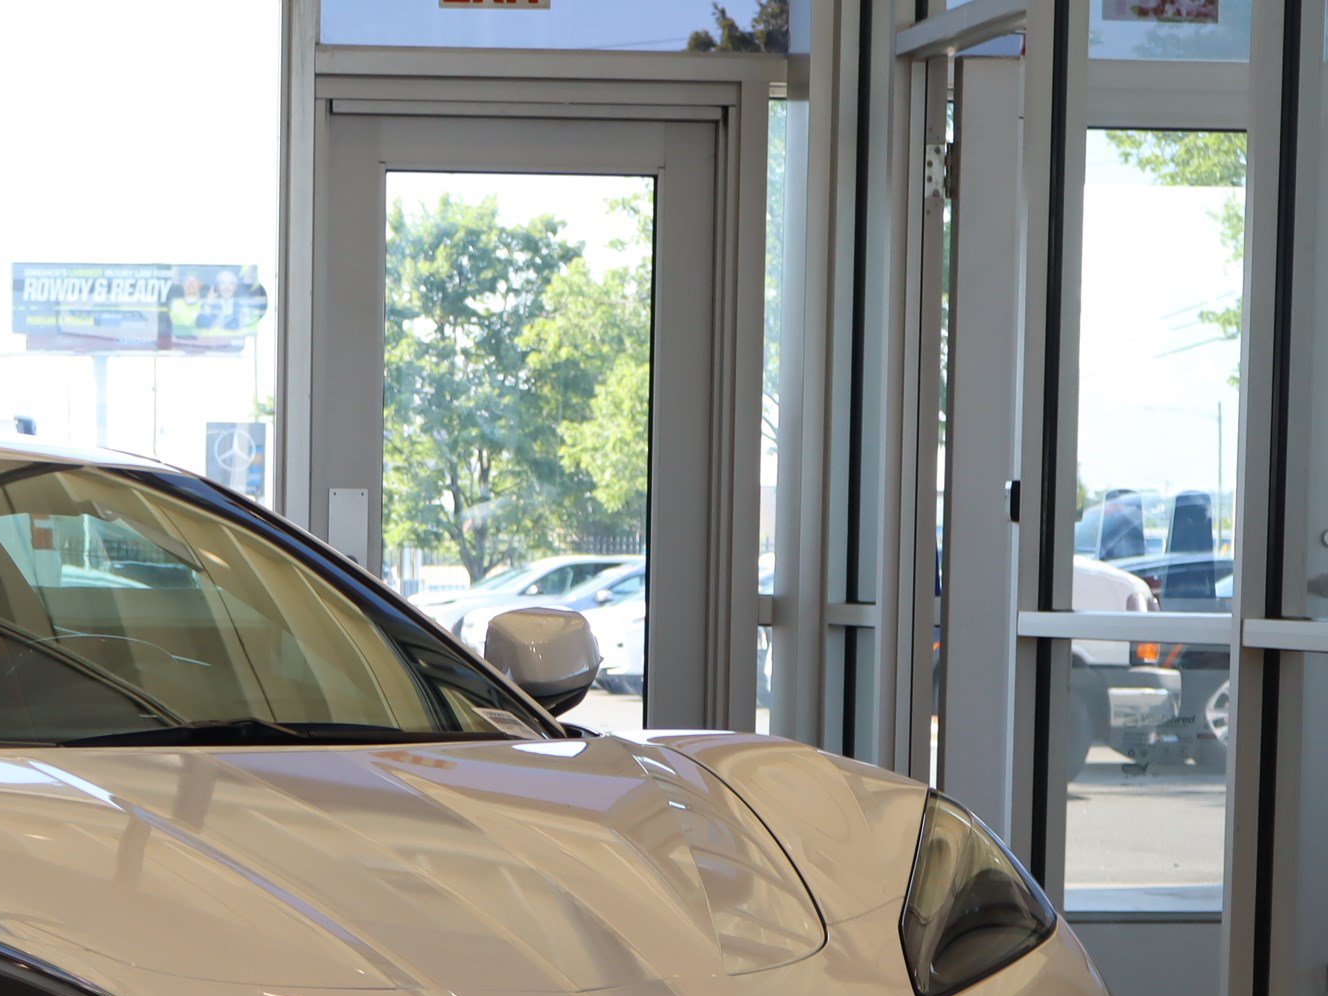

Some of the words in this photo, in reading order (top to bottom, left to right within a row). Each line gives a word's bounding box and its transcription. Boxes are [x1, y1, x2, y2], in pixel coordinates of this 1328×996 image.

[23, 277, 93, 302] ROWDY
[93, 278, 108, 302] &
[110, 278, 172, 303] READY
